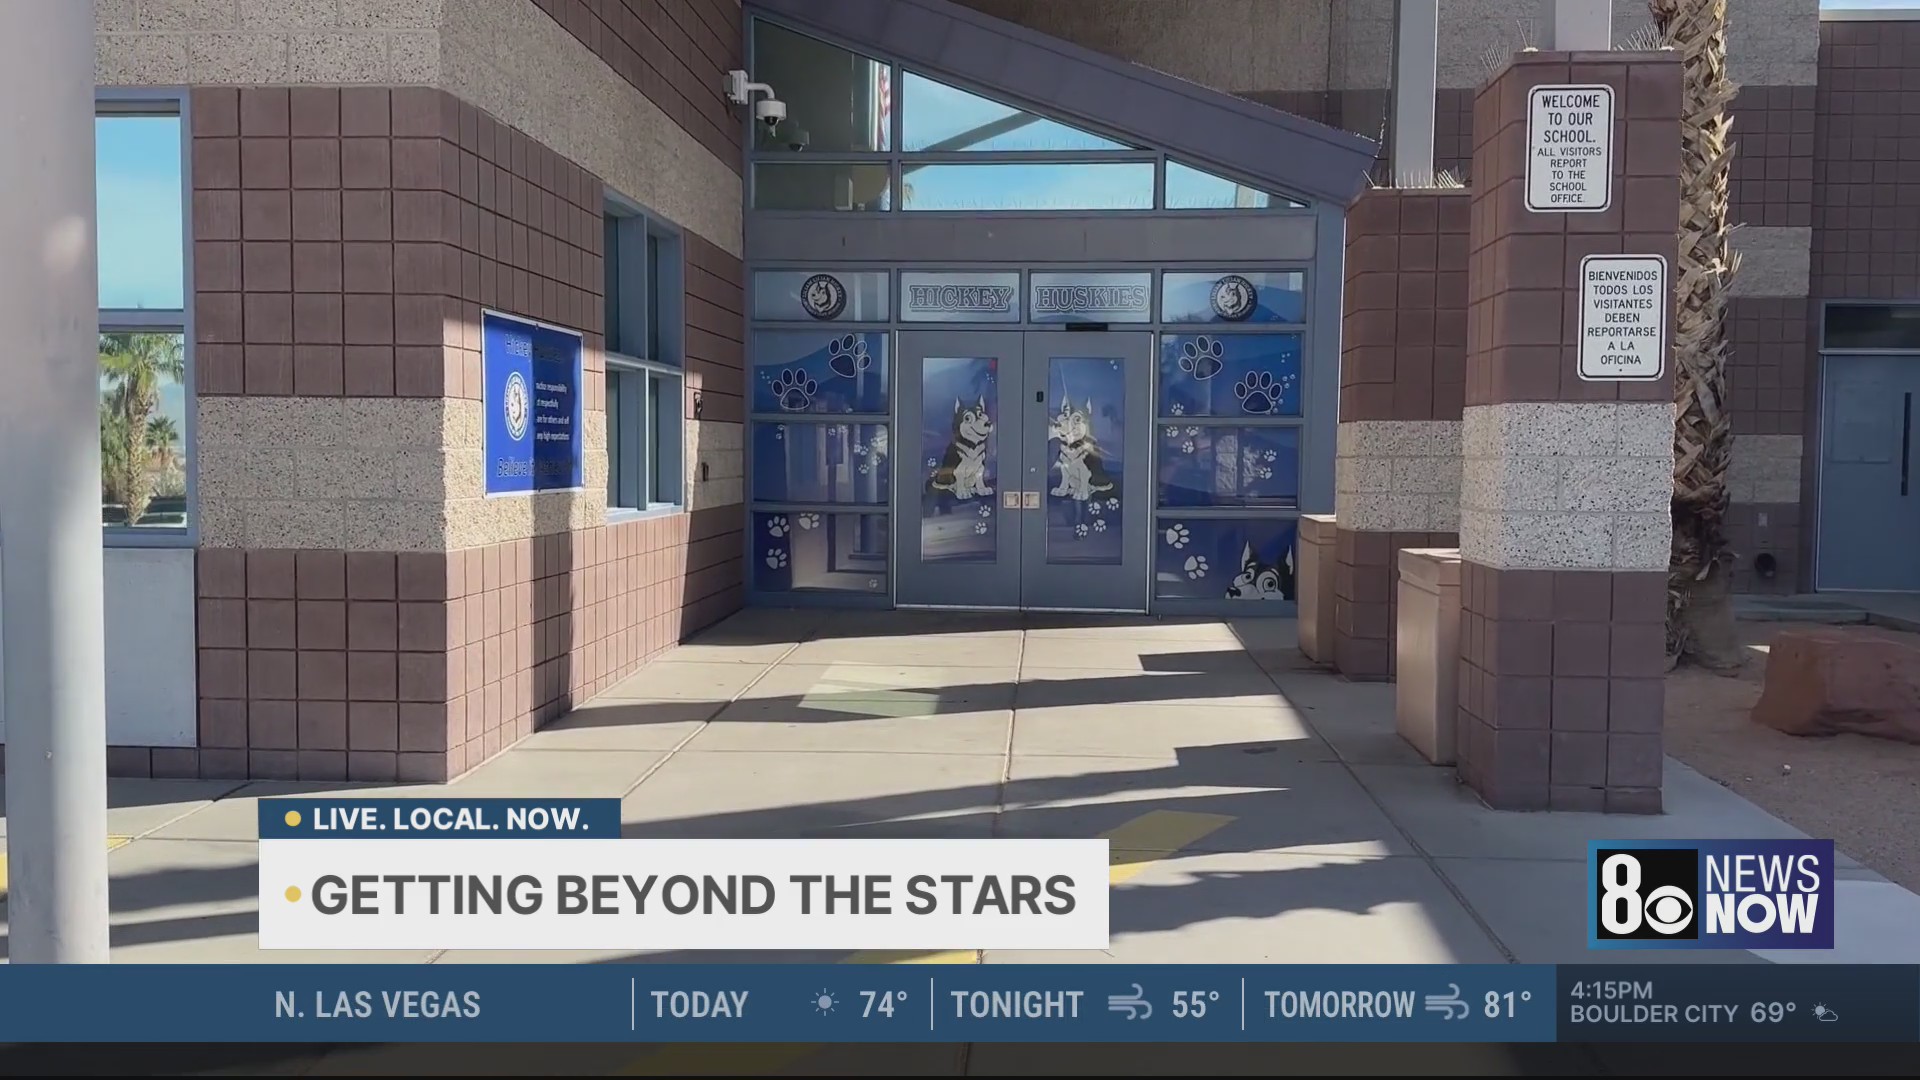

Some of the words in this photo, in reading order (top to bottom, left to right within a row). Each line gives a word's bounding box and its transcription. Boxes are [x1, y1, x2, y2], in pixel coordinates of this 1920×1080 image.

[1542, 95, 1600, 108] WELCOME
[1548, 112, 1562, 125] TO
[1568, 112, 1593, 125] OUR
[1544, 130, 1596, 143] SCHOOL.
[1537, 148, 1555, 156] ALL
[1560, 147, 1602, 156] VISITORS
[1550, 159, 1587, 167] REPORT
[1552, 171, 1563, 179] TO
[1568, 170, 1586, 179] THE
[1549, 182, 1587, 191] SCHOOL
[1588, 271, 1658, 281] BIENVENIDOS
[1593, 285, 1628, 295] TODOS
[1633, 285, 1653, 295] LOS
[909, 285, 1014, 312] HICKEY
[1035, 285, 1148, 312] HUSKIES
[1593, 299, 1653, 309] VISITANTES
[1605, 313, 1640, 323] DEBEN
[1587, 327, 1656, 337] REPORTARSE
[1607, 341, 1615, 350] A
[1620, 341, 1635, 350] LA
[1600, 355, 1641, 365] OFICINA
[497, 456, 527, 477] Believe
